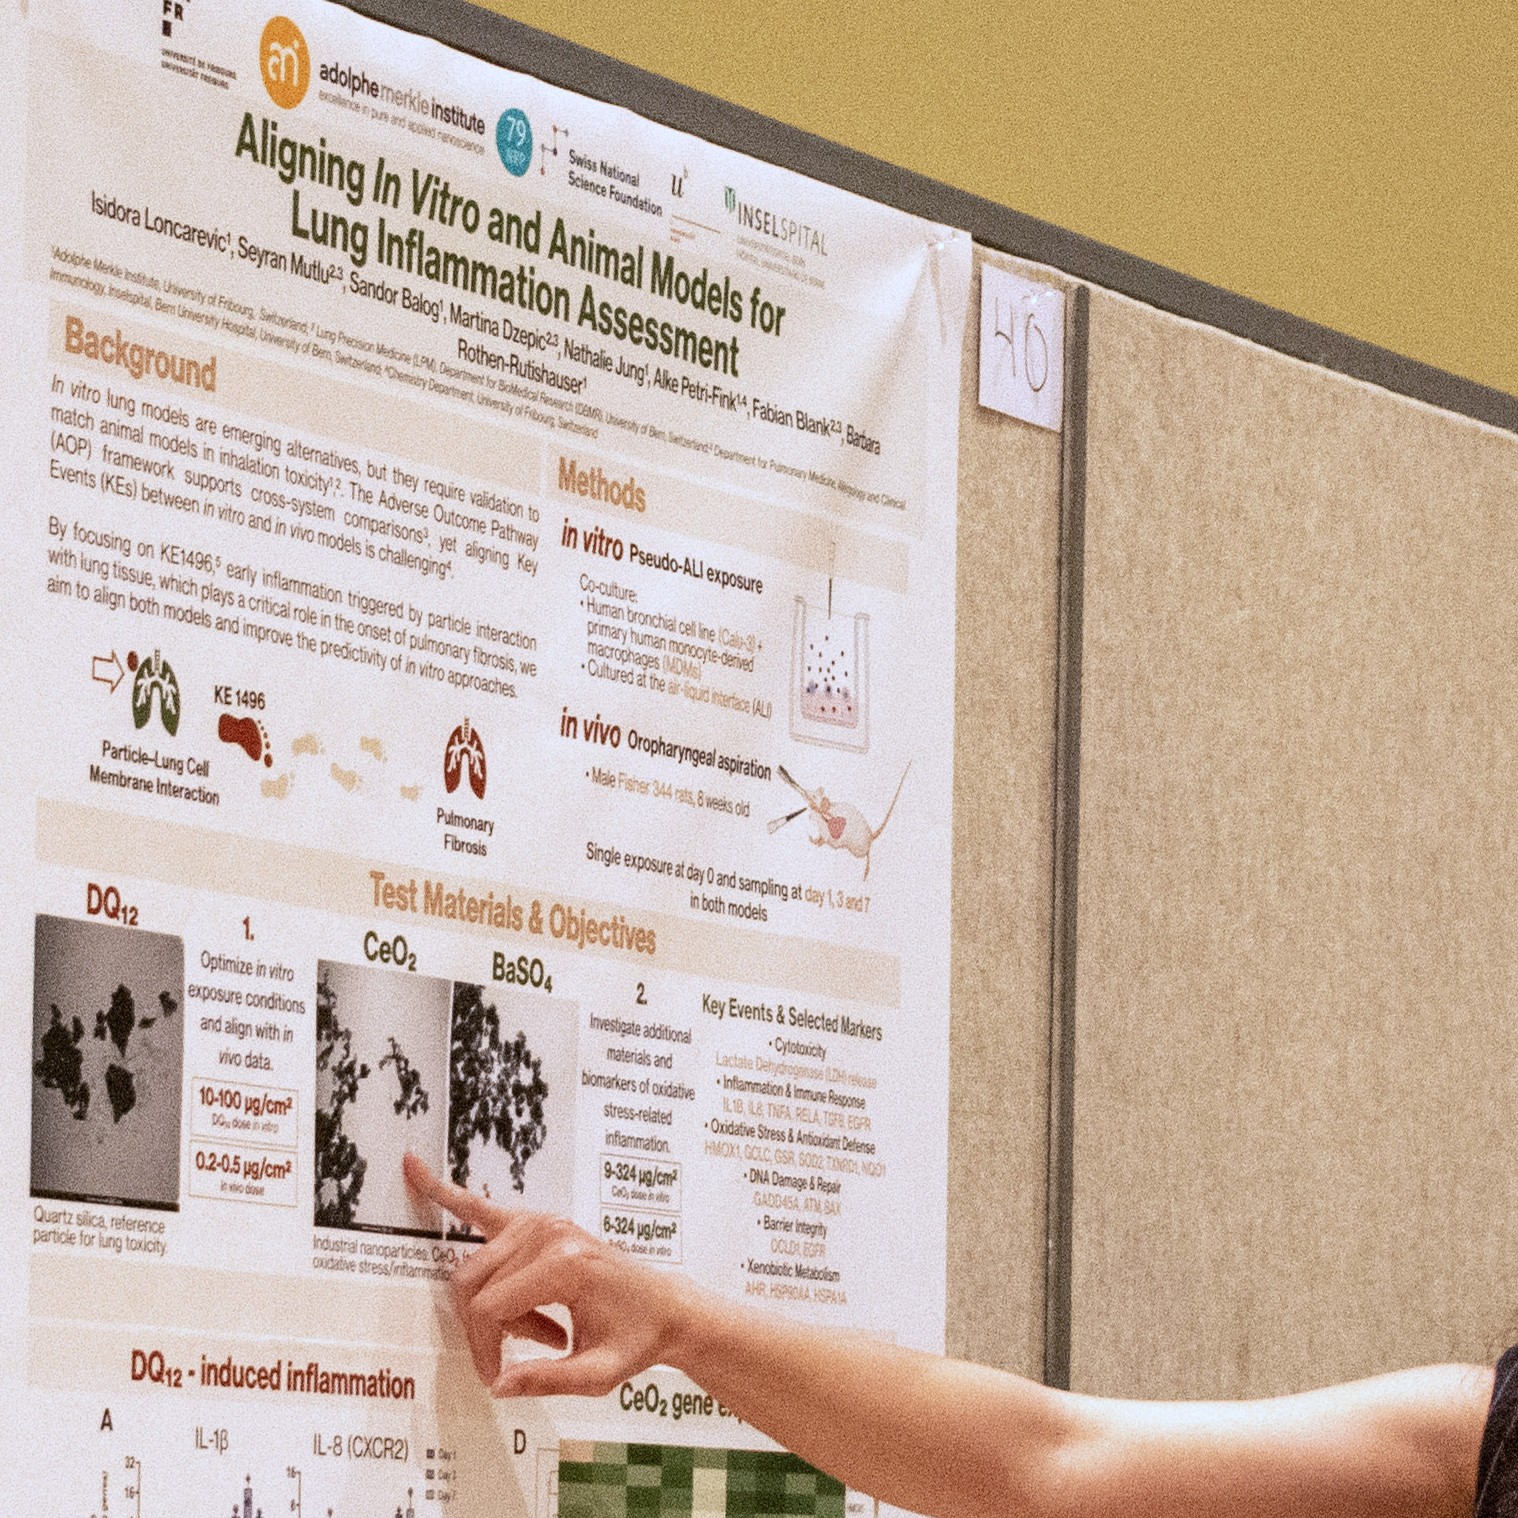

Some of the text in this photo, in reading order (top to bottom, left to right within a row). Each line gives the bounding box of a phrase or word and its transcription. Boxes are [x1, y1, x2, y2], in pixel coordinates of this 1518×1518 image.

[506, 115, 528, 148] 79
[568, 149, 640, 187] Swiss National
[567, 171, 663, 216] Science Foundation
[235, 114, 365, 206] Aligning
[373, 157, 401, 220] In
[412, 168, 480, 234] Vitro
[488, 208, 541, 254] and
[548, 217, 644, 289] Animal
[651, 251, 742, 323] Models
[750, 287, 786, 336] for
[292, 190, 739, 377] Lung Inflammation Assessment
[90, 191, 142, 227] Isidora
[237, 235, 288, 271] Seyran
[349, 271, 399, 305] Sandor
[449, 302, 500, 337] Martina
[563, 338, 614, 372] Nathalie
[652, 367, 680, 393] Alke
[752, 398, 794, 427] Fabian
[845, 424, 881, 455] Barbara
[65, 316, 216, 392] Background
[50, 374, 541, 523] In vitro lung models are emerging alternatives, but they require validation to
[558, 456, 646, 513] Methods
[560, 518, 764, 594] in vitro Pseudo-ALI exposure
[213, 685, 266, 710] KE 1496
[559, 706, 772, 780] in vivo Oropharyngeal aspiration
[88, 764, 220, 805] Membrane Interaction
[186, 757, 210, 777] Cell
[436, 807, 495, 836] Pulmonary
[443, 833, 488, 857] Fibrosis
[369, 870, 656, 956] Test Materials & Objectives
[199, 952, 295, 982] Optimize in vitro
[188, 984, 306, 1014] exposure conditions
[199, 1016, 294, 1042] and align with in
[701, 994, 883, 1041] Key Events & Selected Markers
[606, 1048, 674, 1069] materials and
[603, 1103, 673, 1126] stress-related
[200, 1355, 282, 1391] induced
[286, 1361, 416, 1399] inflammation
[100, 1408, 114, 1431] A
[672, 1389, 714, 1420] gene
[312, 1434, 410, 1462] IL-8 (CXCR2)
[513, 1429, 528, 1454] D
